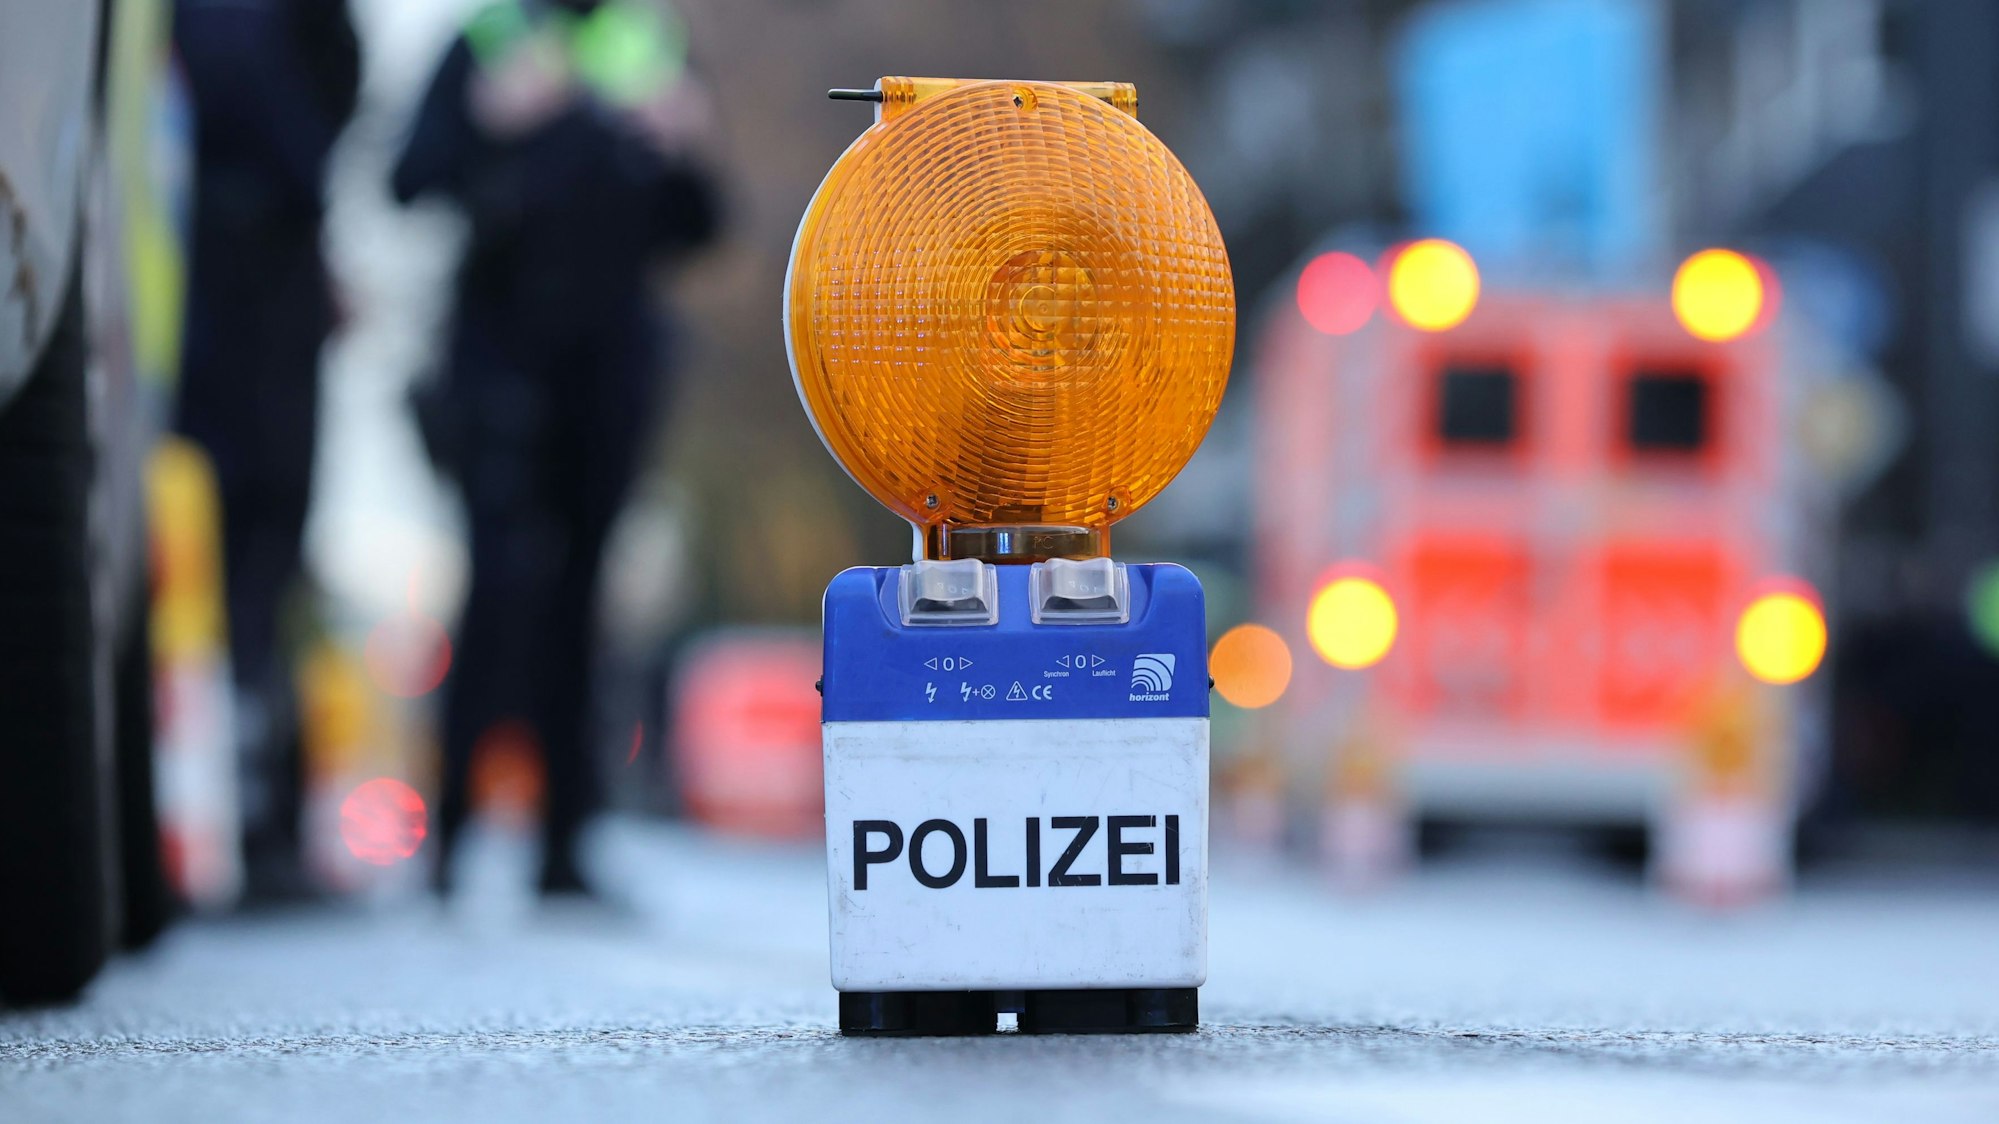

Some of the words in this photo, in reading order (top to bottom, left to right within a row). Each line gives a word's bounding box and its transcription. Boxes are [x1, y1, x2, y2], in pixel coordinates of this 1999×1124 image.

[1043, 670, 1070, 678] Synchron
[1031, 685, 1053, 699] CE
[1129, 692, 1170, 702] horizont
[854, 814, 1180, 891] POLIZEI
